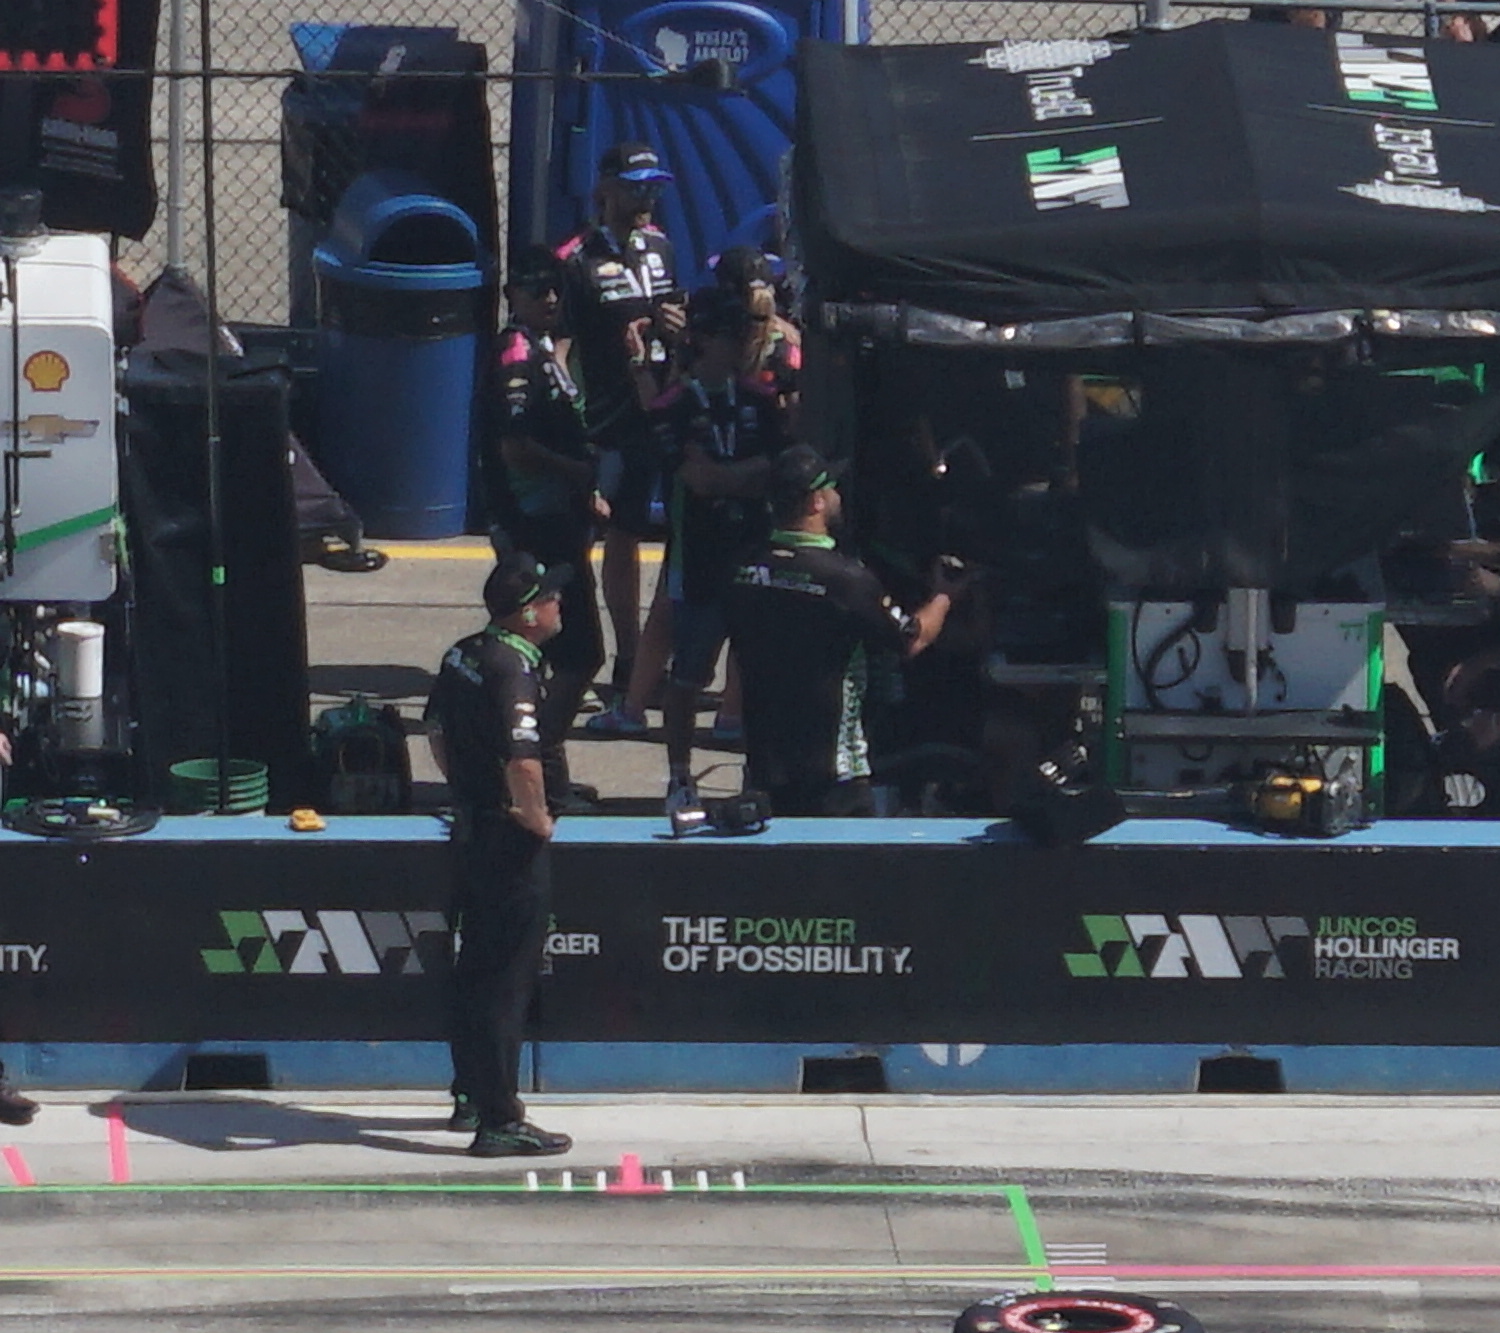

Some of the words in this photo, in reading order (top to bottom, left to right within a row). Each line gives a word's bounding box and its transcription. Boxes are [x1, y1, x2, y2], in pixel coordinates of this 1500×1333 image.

[662, 916, 727, 944] THE
[734, 918, 856, 944] POWER
[1315, 917, 1418, 938] JUNCOS
[662, 946, 709, 973] OF
[716, 946, 913, 974] POSSIBILITY.
[1314, 938, 1460, 961] HOLLINGER
[1315, 960, 1413, 980] RACING
